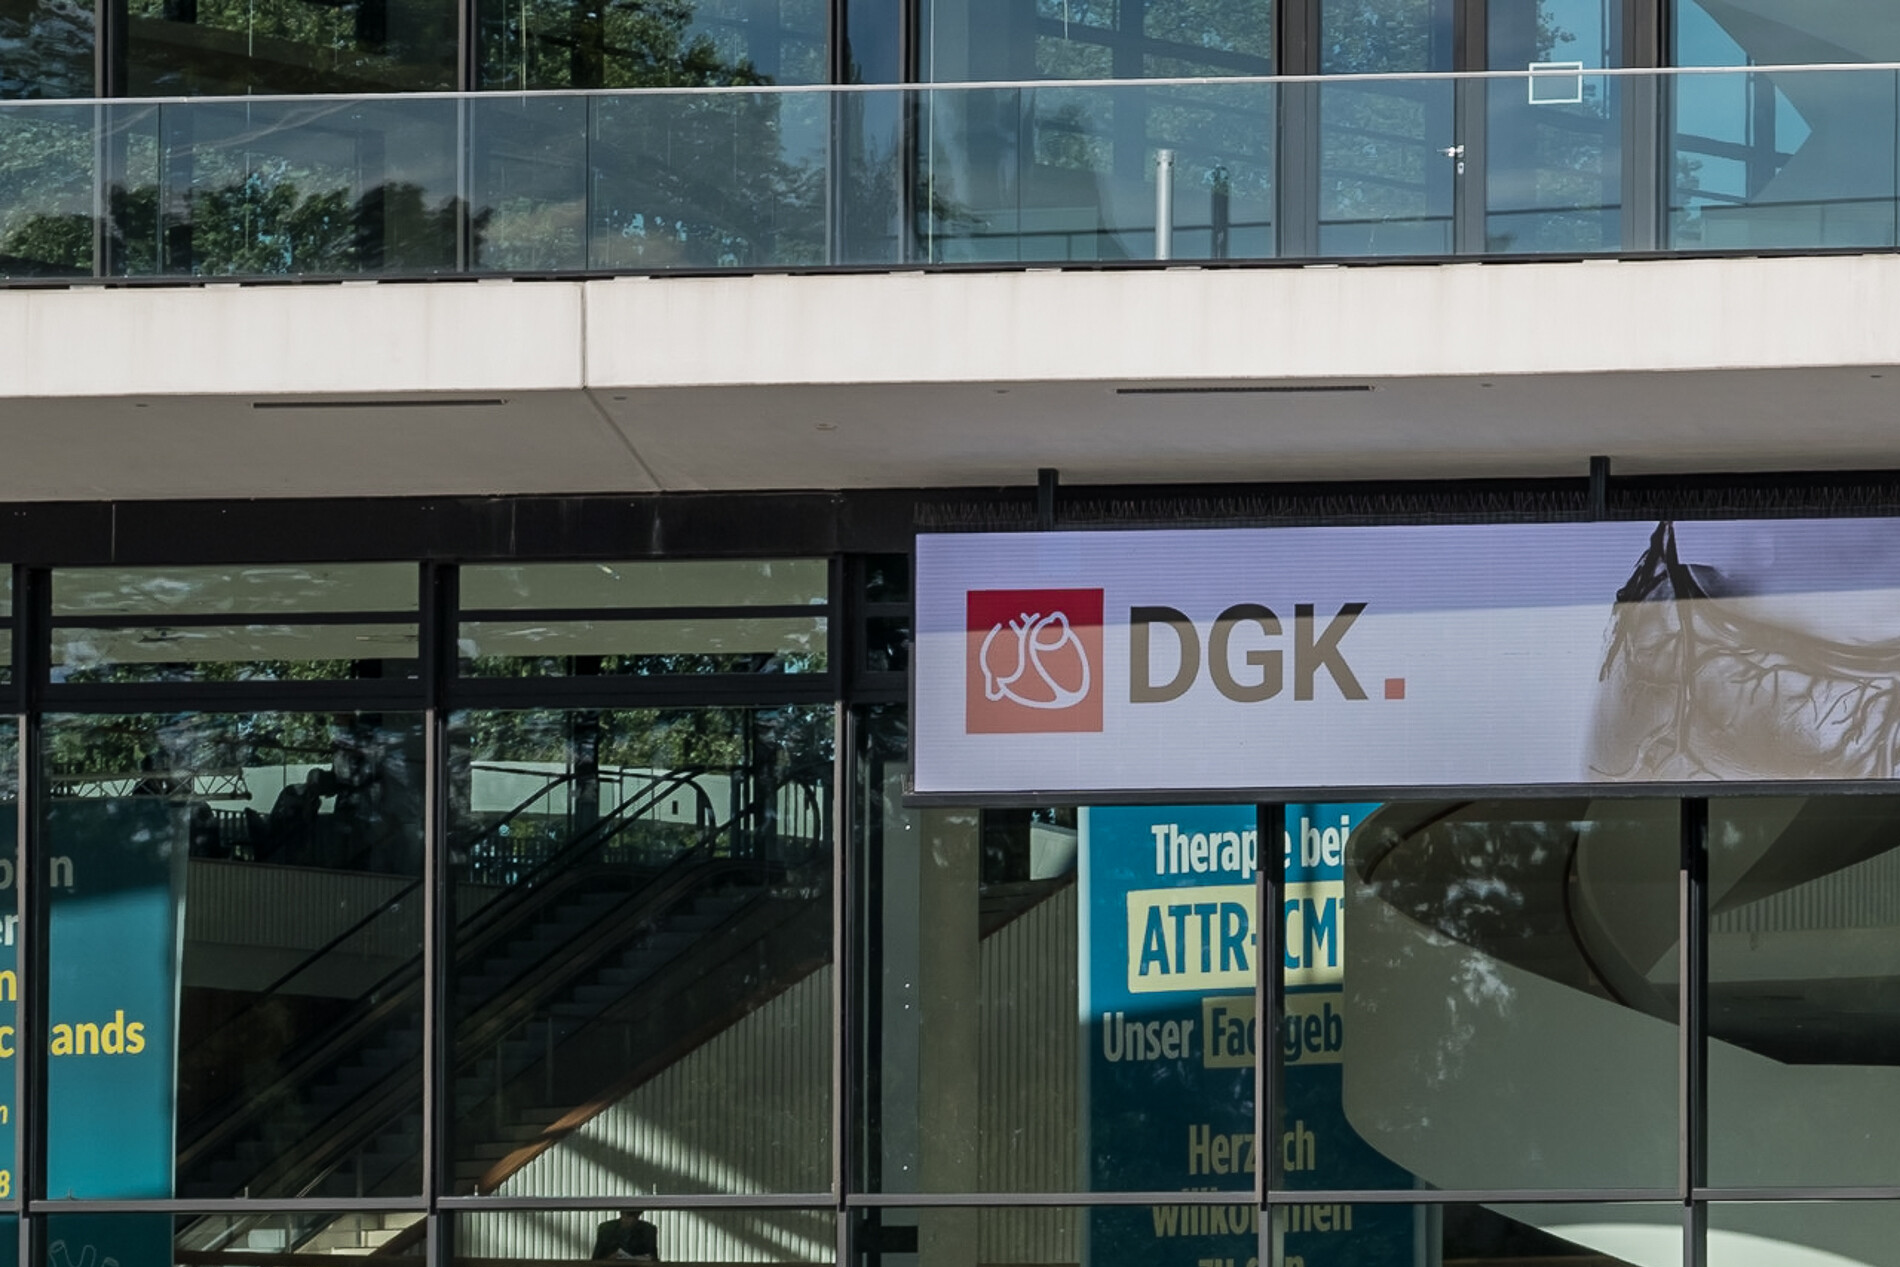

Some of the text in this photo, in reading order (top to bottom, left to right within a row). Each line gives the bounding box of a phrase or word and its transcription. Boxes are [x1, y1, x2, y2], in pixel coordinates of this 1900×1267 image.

[1128, 601, 1406, 704] DGK.
[1151, 823, 1291, 880] Therap
[1102, 1011, 1195, 1063] Unser
[1188, 1120, 1316, 1176] Herzch
[1152, 1187, 1353, 1238] willkomen
